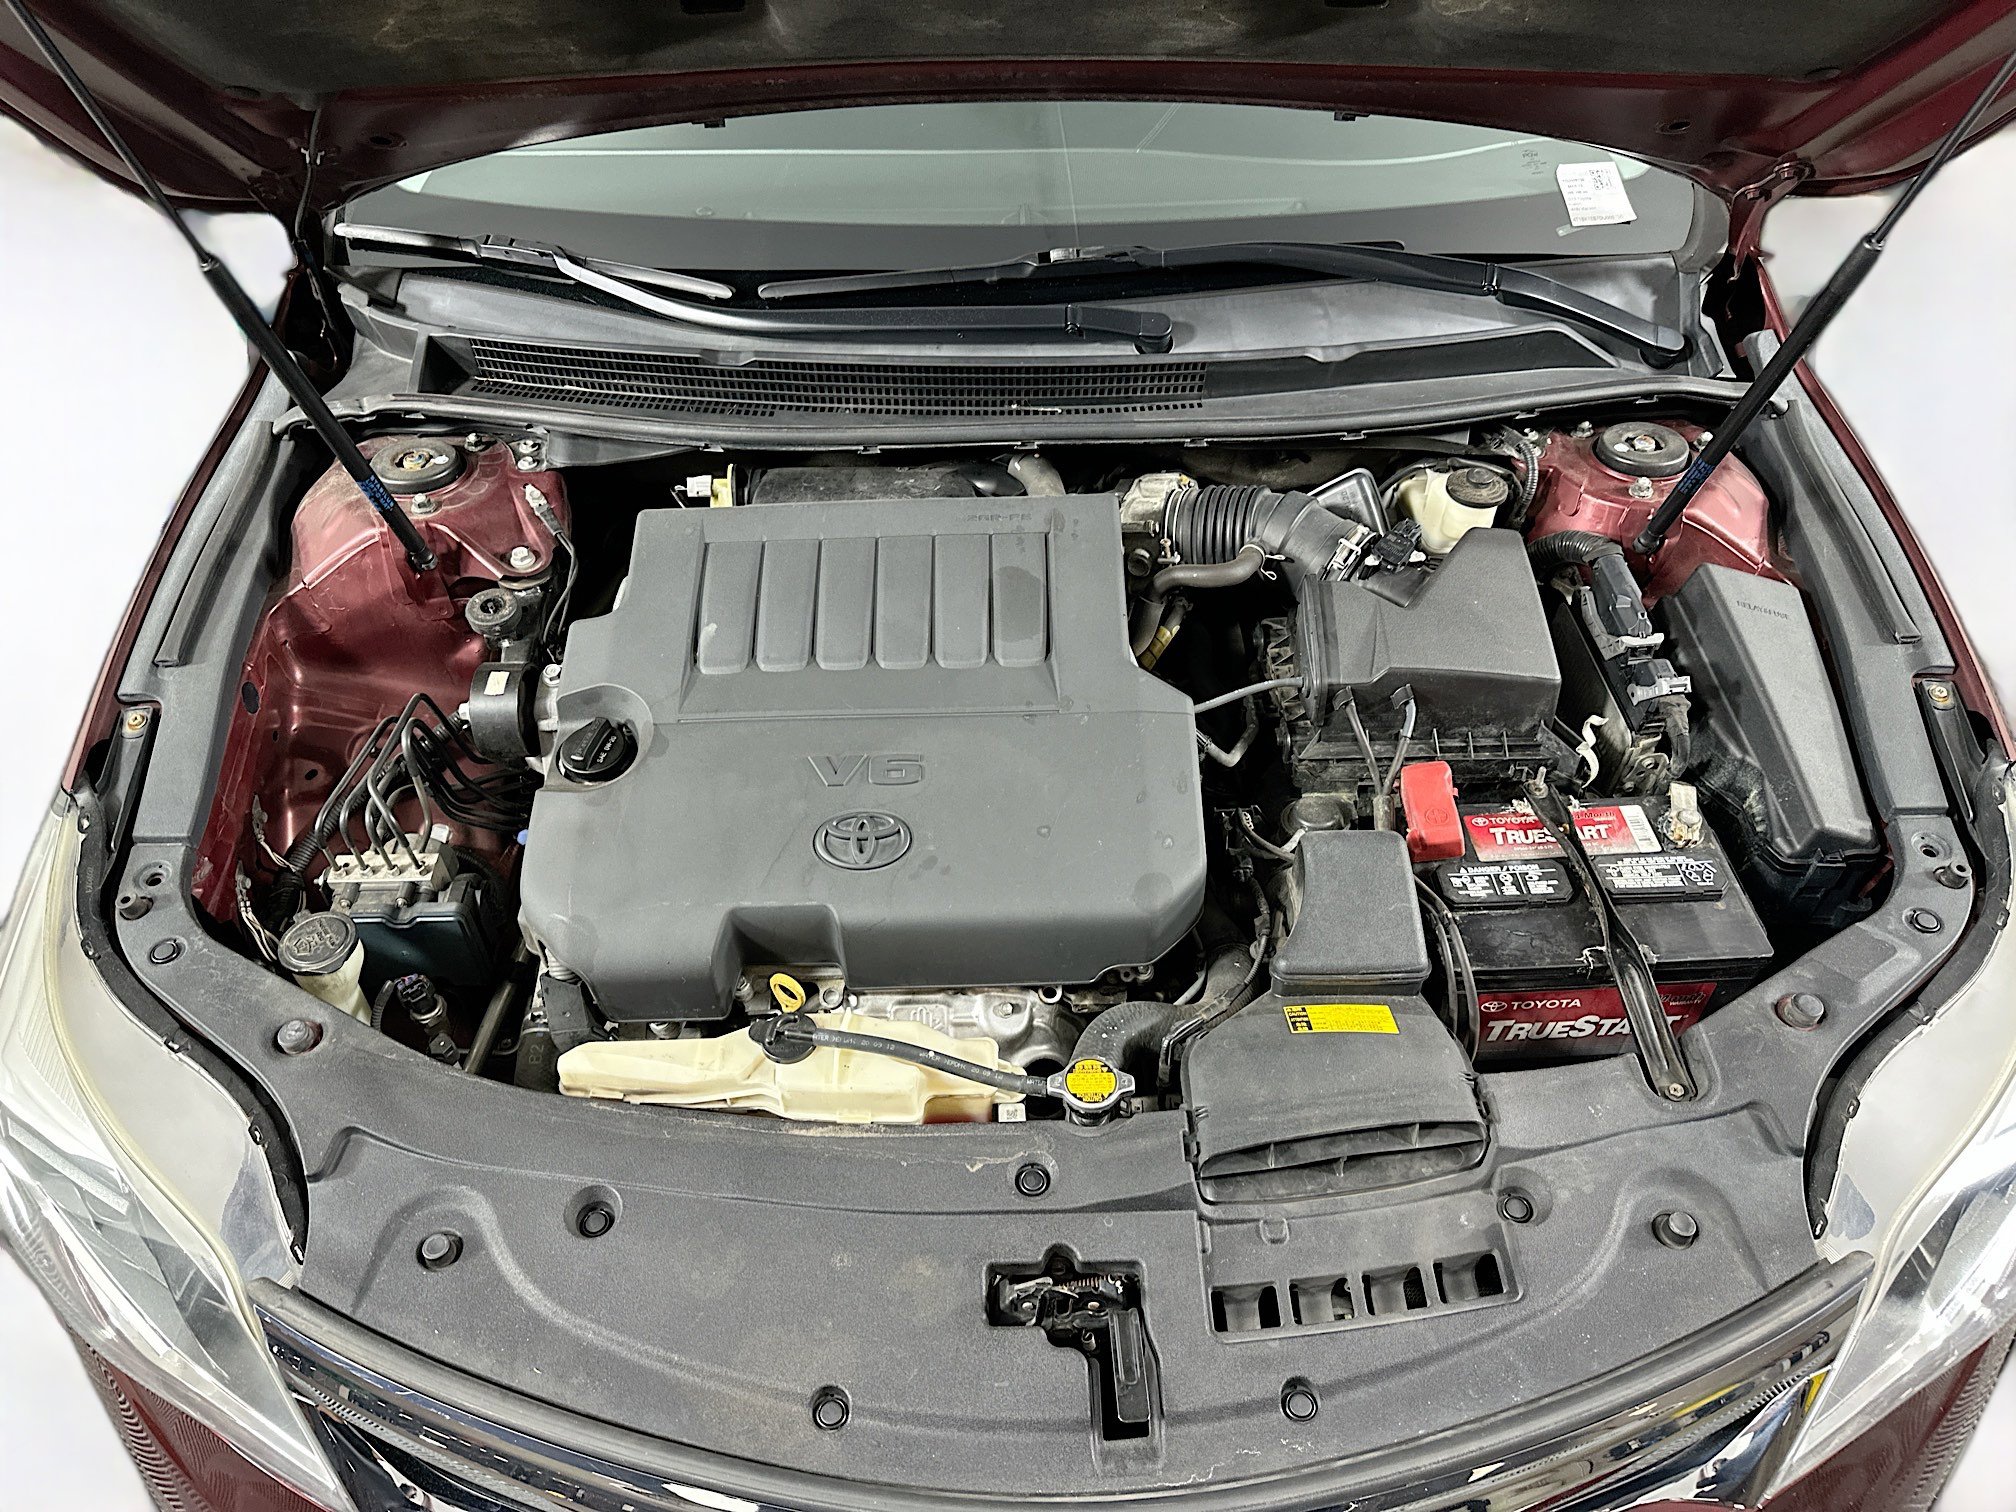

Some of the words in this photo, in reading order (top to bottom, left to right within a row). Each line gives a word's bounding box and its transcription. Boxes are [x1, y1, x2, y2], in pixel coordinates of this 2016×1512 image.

[597, 752, 607, 763] SAE
[806, 752, 924, 788] V6
[1489, 815, 1535, 826] TOYOTA
[1511, 998, 1582, 1010] TOYOTA
[1486, 1014, 1683, 1043] TRUESTAT
[812, 1032, 830, 1042] ATER
[970, 1066, 980, 1074] 20
